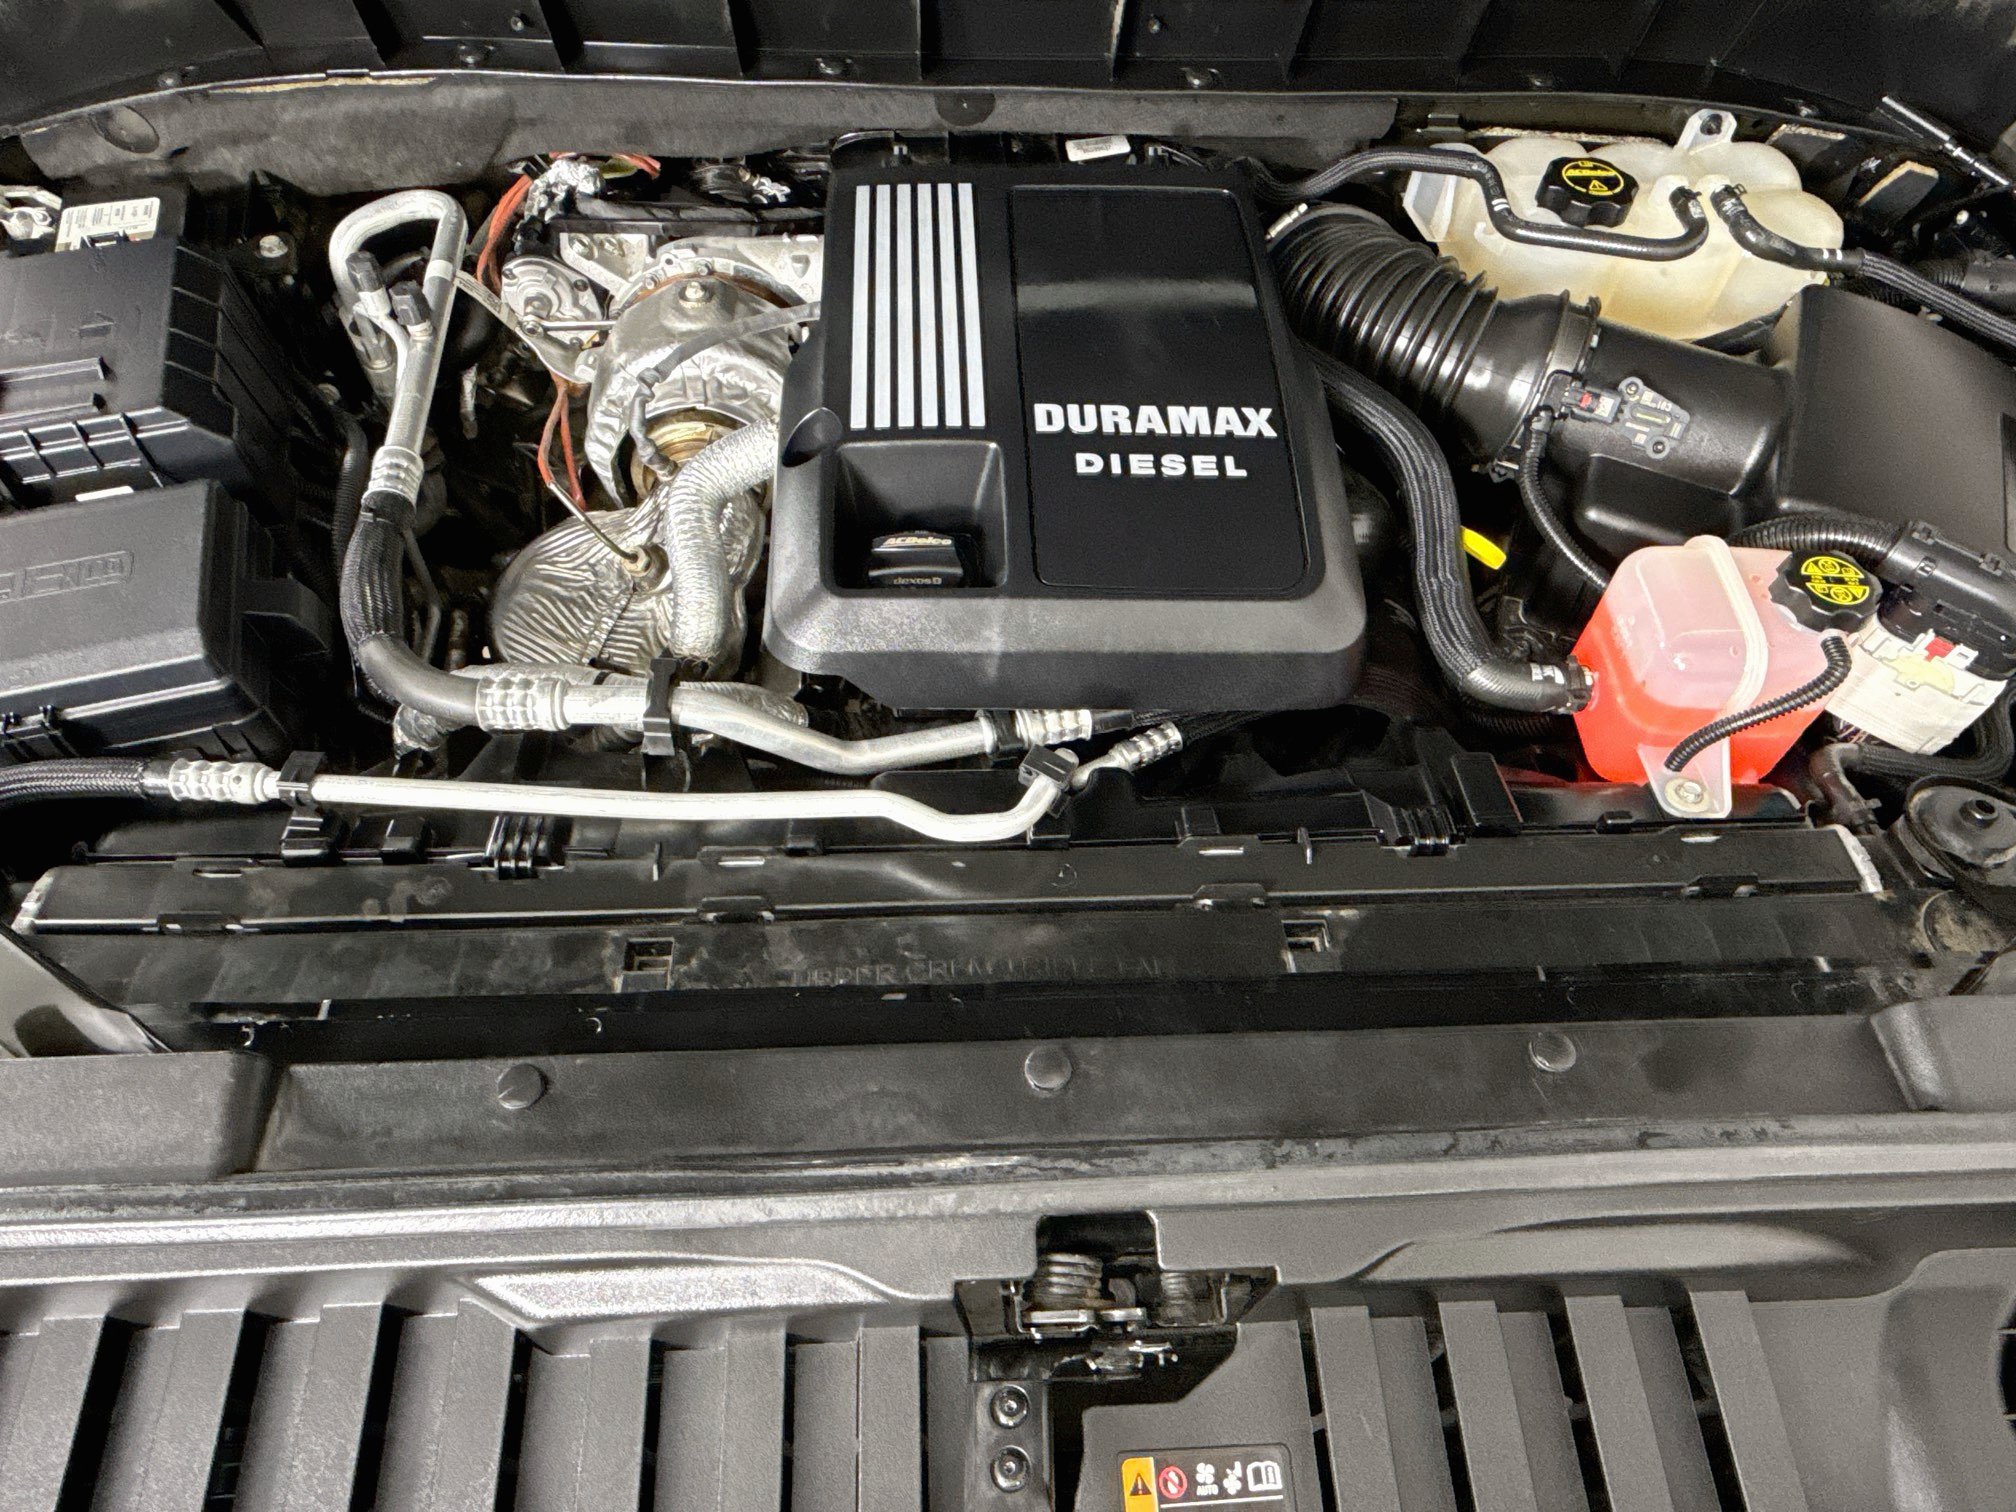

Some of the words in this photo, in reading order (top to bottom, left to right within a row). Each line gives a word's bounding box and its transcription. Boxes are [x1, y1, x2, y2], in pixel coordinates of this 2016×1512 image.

[1033, 403, 1278, 438] DURAMAX
[1075, 452, 1248, 477] DIESEL
[881, 536, 952, 546] ACDelco
[1196, 1484, 1218, 1496] AUTO
